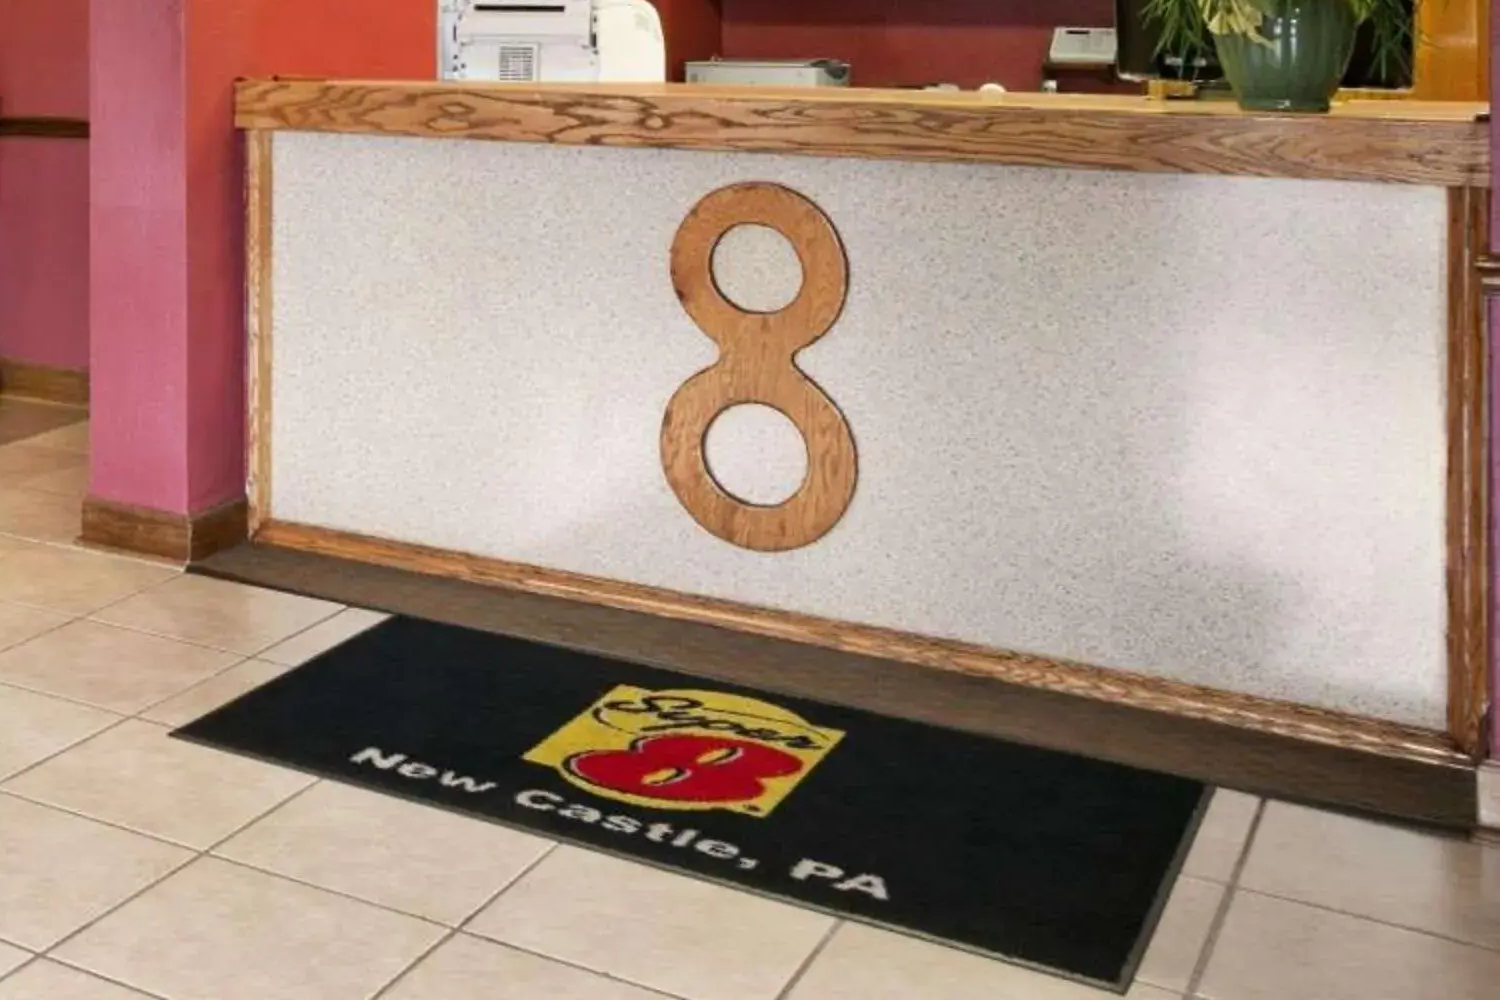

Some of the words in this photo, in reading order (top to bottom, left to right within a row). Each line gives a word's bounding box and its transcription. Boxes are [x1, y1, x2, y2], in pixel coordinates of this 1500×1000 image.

[660, 181, 858, 551] 8
[560, 730, 804, 804] 8
[594, 695, 830, 750] Super
[349, 746, 498, 793] New
[515, 788, 761, 870] Castle,
[789, 858, 890, 901] PA
